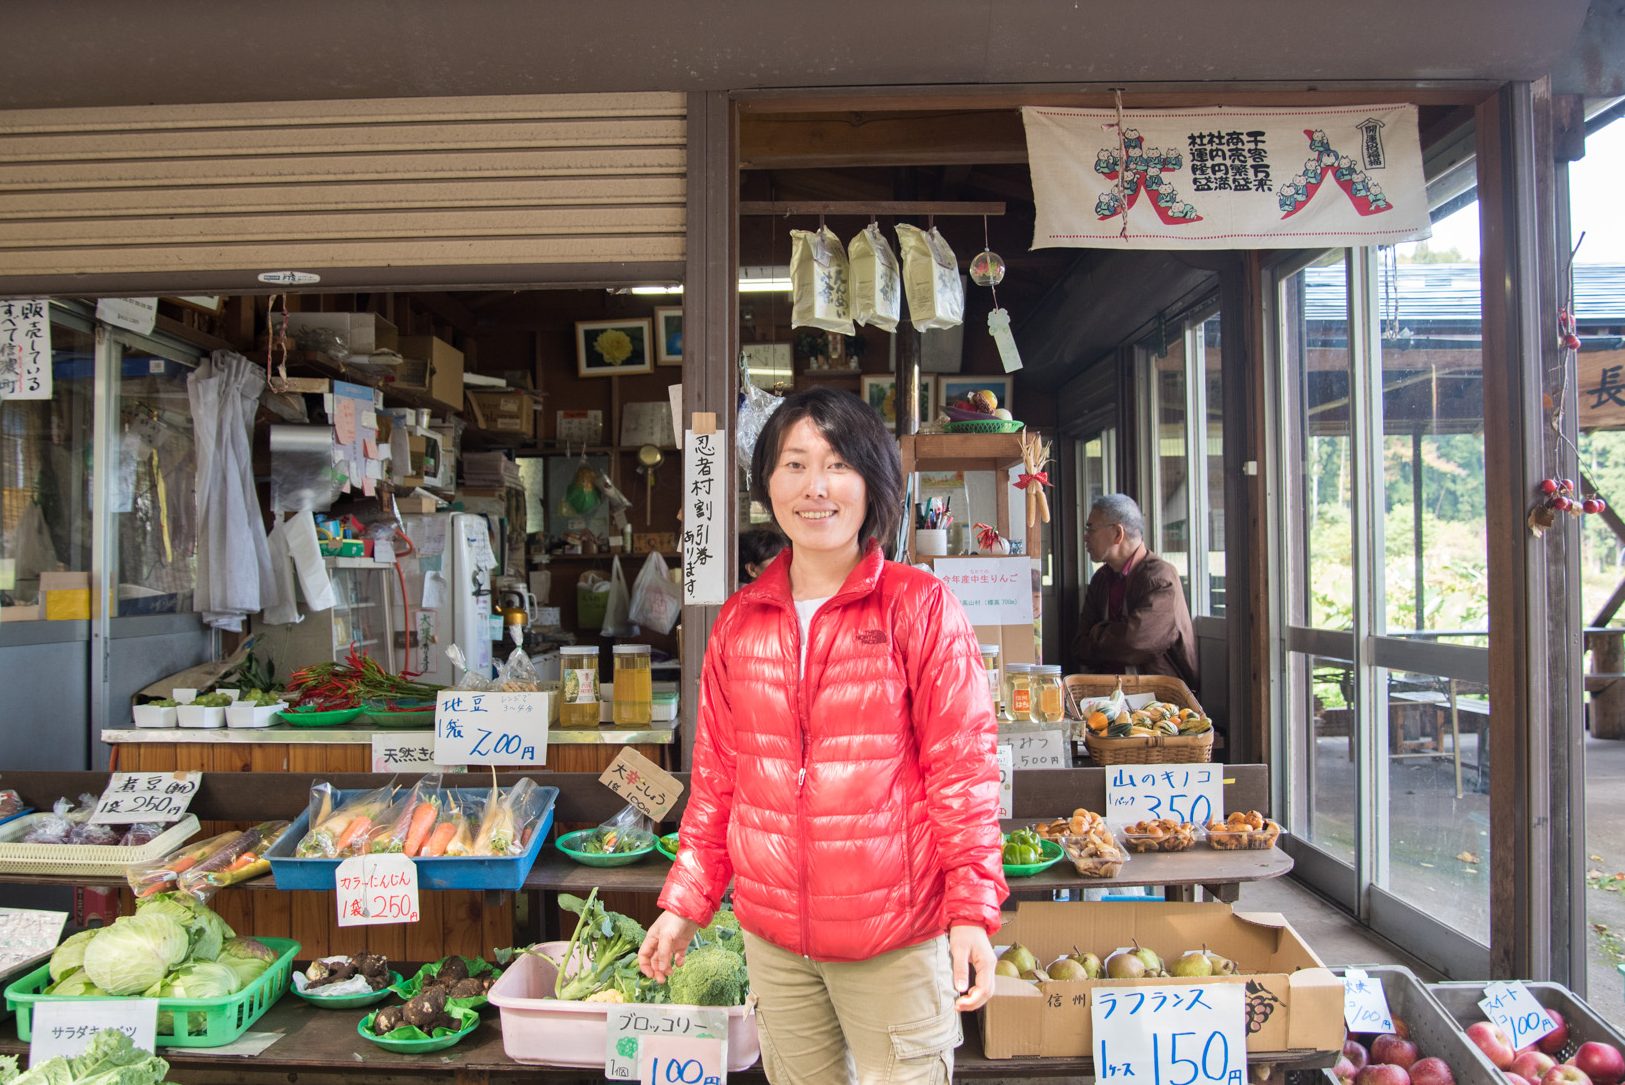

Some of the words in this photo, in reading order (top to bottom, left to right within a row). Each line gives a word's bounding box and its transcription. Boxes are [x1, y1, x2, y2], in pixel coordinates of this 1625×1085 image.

[1187, 131, 1214, 192] 社運隆盛
[1207, 131, 1233, 192] 社内円満
[1226, 131, 1253, 192] 商売繁盛
[1246, 131, 1273, 192] 千客万来
[0, 299, 20, 394] すべて信濃町
[21, 299, 44, 392] 販売している
[1587, 364, 1625, 409] 長
[691, 434, 715, 566] 忍者村割引券
[442, 694, 488, 713] 地豆
[469, 728, 535, 760] 200円
[1013, 755, 1059, 768] ,500円
[611, 764, 666, 806] 大辛こしょう
[1113, 769, 1211, 789] 山のキノコ
[124, 796, 181, 815] 250円
[626, 791, 651, 814] 100円
[1143, 794, 1211, 826] 350
[340, 872, 411, 890] カラーにんじん
[371, 893, 418, 922] 250円
[1047, 993, 1086, 1008] 信州
[1099, 988, 1212, 1019] ラフランス
[1484, 988, 1518, 1015] スイート
[52, 1025, 137, 1040] サラダキツ
[619, 1012, 708, 1033] ブロッコリー
[1351, 1005, 1392, 1030] 100円
[1509, 1011, 1554, 1048] 100円
[610, 1058, 629, 1077] 1個
[651, 1057, 721, 1085] 100円
[1101, 1039, 1136, 1079] 1ケース
[1152, 1030, 1242, 1085] 150円
